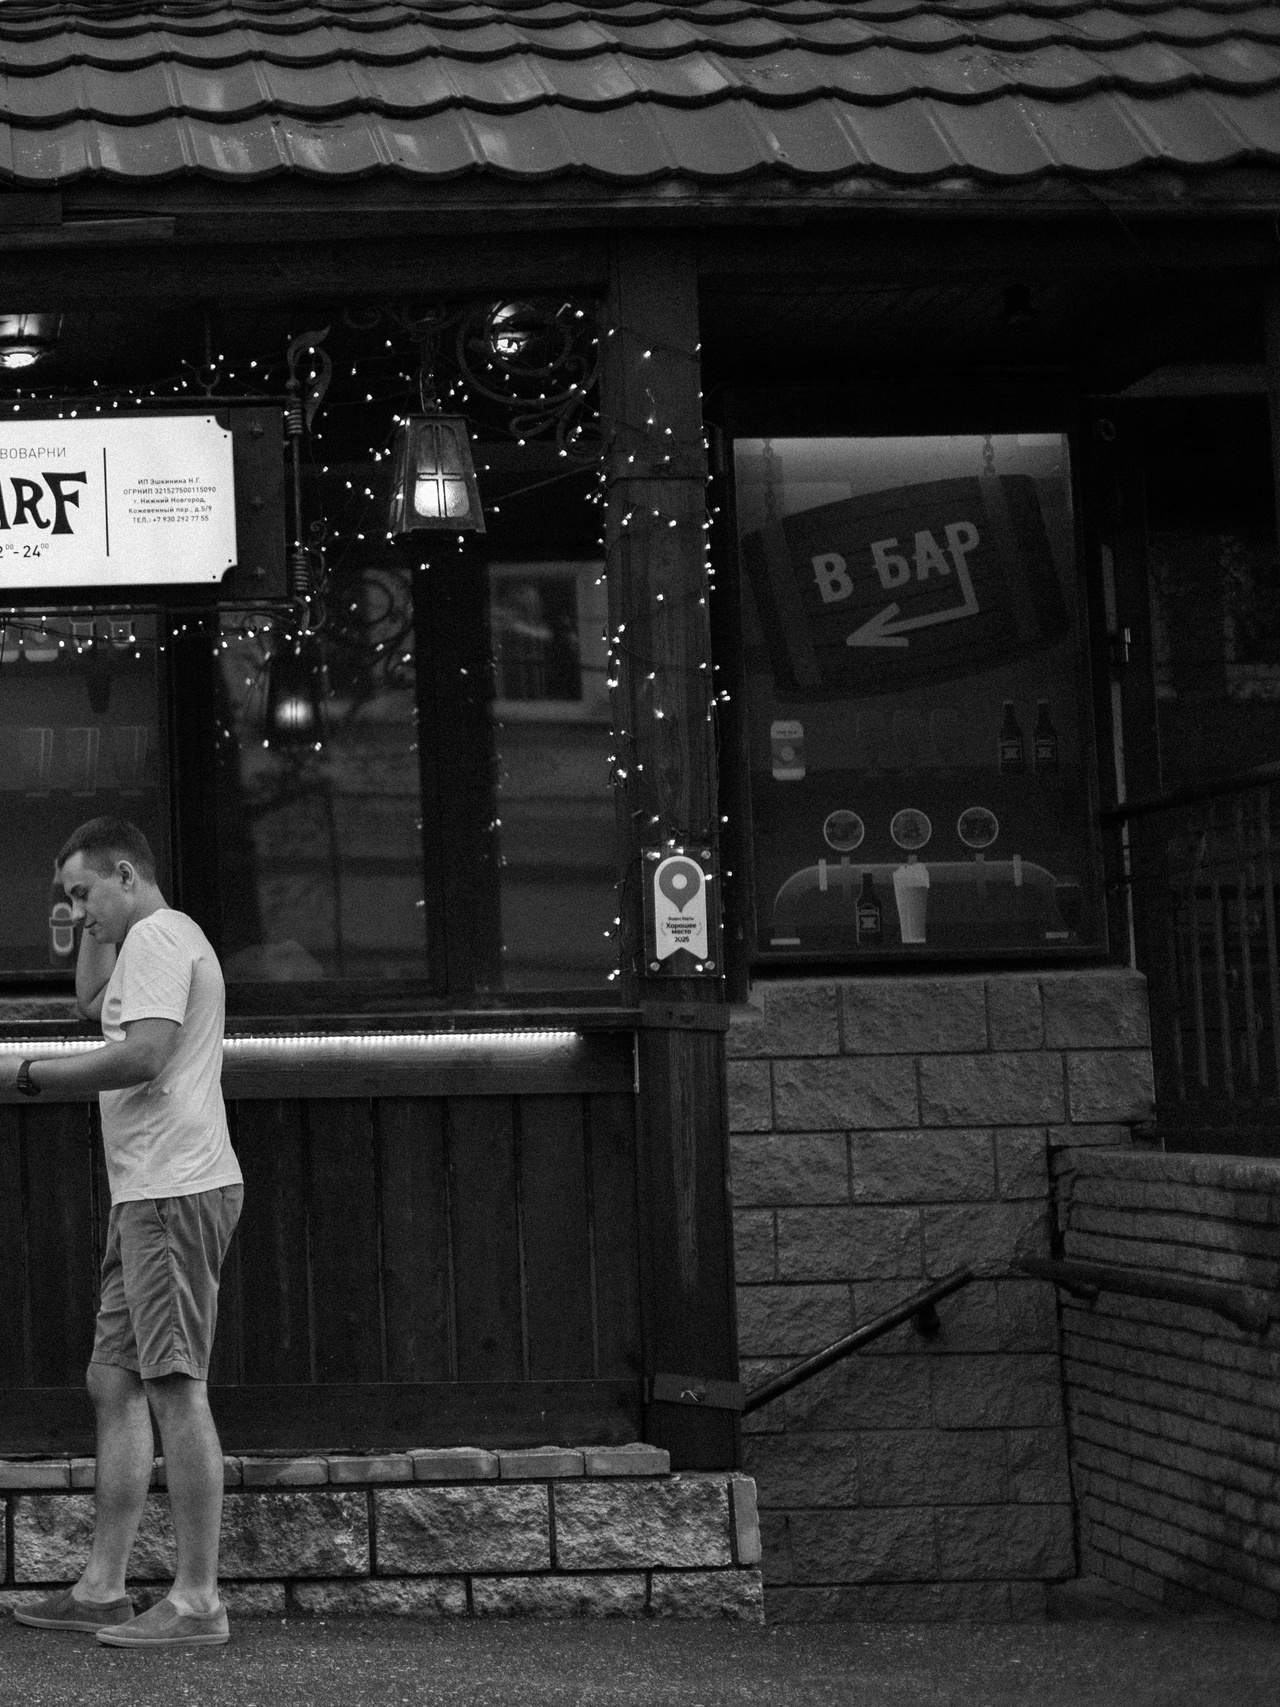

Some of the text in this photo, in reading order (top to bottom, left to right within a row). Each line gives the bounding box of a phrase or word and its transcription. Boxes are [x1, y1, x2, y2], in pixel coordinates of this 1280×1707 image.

[140, 496, 169, 505] Нижний
[812, 521, 980, 604] В БАР
[666, 922, 697, 930] Хорошее
